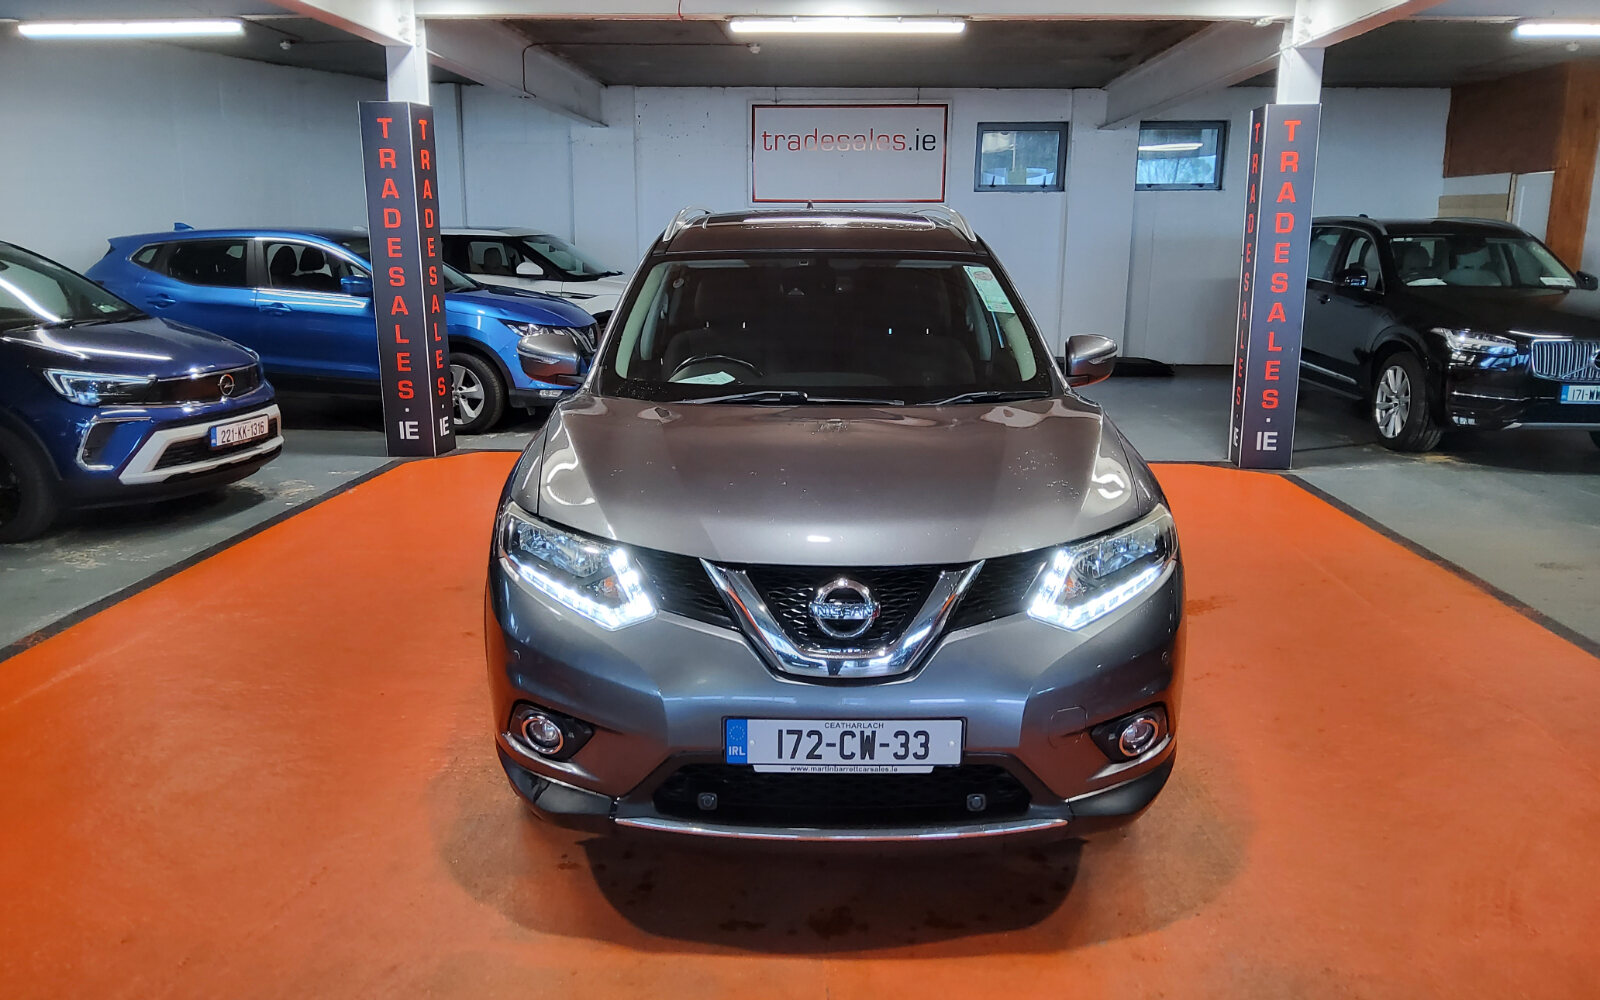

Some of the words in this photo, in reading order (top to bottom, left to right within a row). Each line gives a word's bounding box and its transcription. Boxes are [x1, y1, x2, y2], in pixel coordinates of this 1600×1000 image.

[761, 127, 937, 151] tradesales.ie
[220, 420, 265, 444] 221-KK-1316
[813, 603, 873, 618] NISSAN
[824, 721, 884, 729] CEATHARLACH
[728, 746, 746, 756] IRL
[777, 729, 930, 761] 172-CW-33
